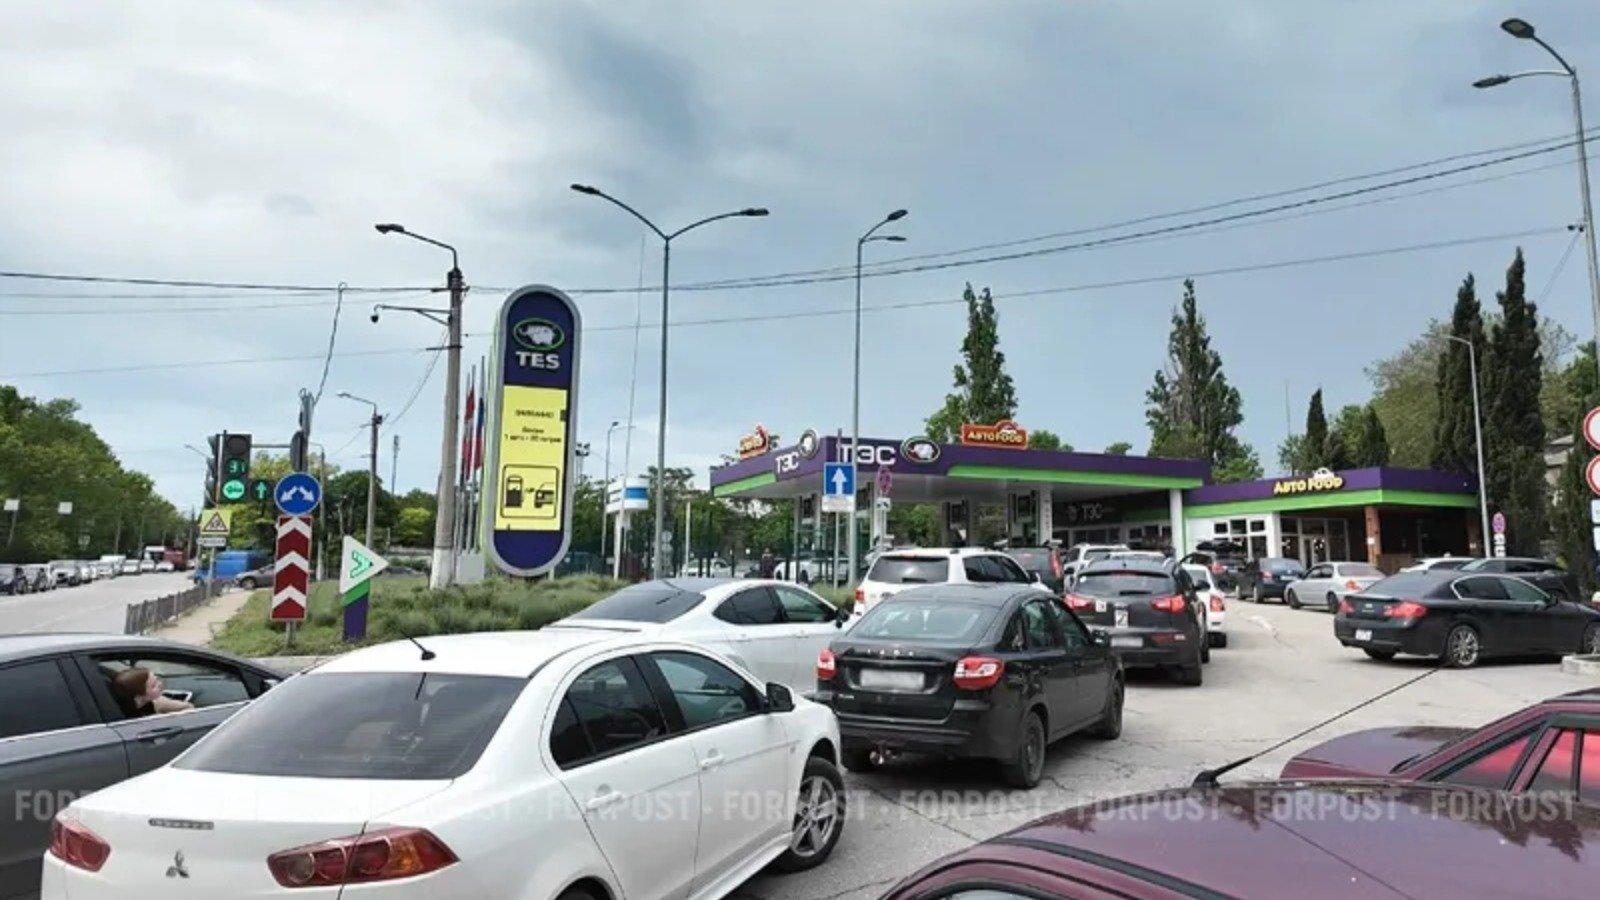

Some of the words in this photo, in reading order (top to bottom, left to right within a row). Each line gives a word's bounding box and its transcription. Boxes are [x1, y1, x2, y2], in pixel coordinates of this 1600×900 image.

[515, 351, 560, 369] TES
[775, 452, 799, 473] ТЭС
[836, 444, 896, 465] ТЭС
